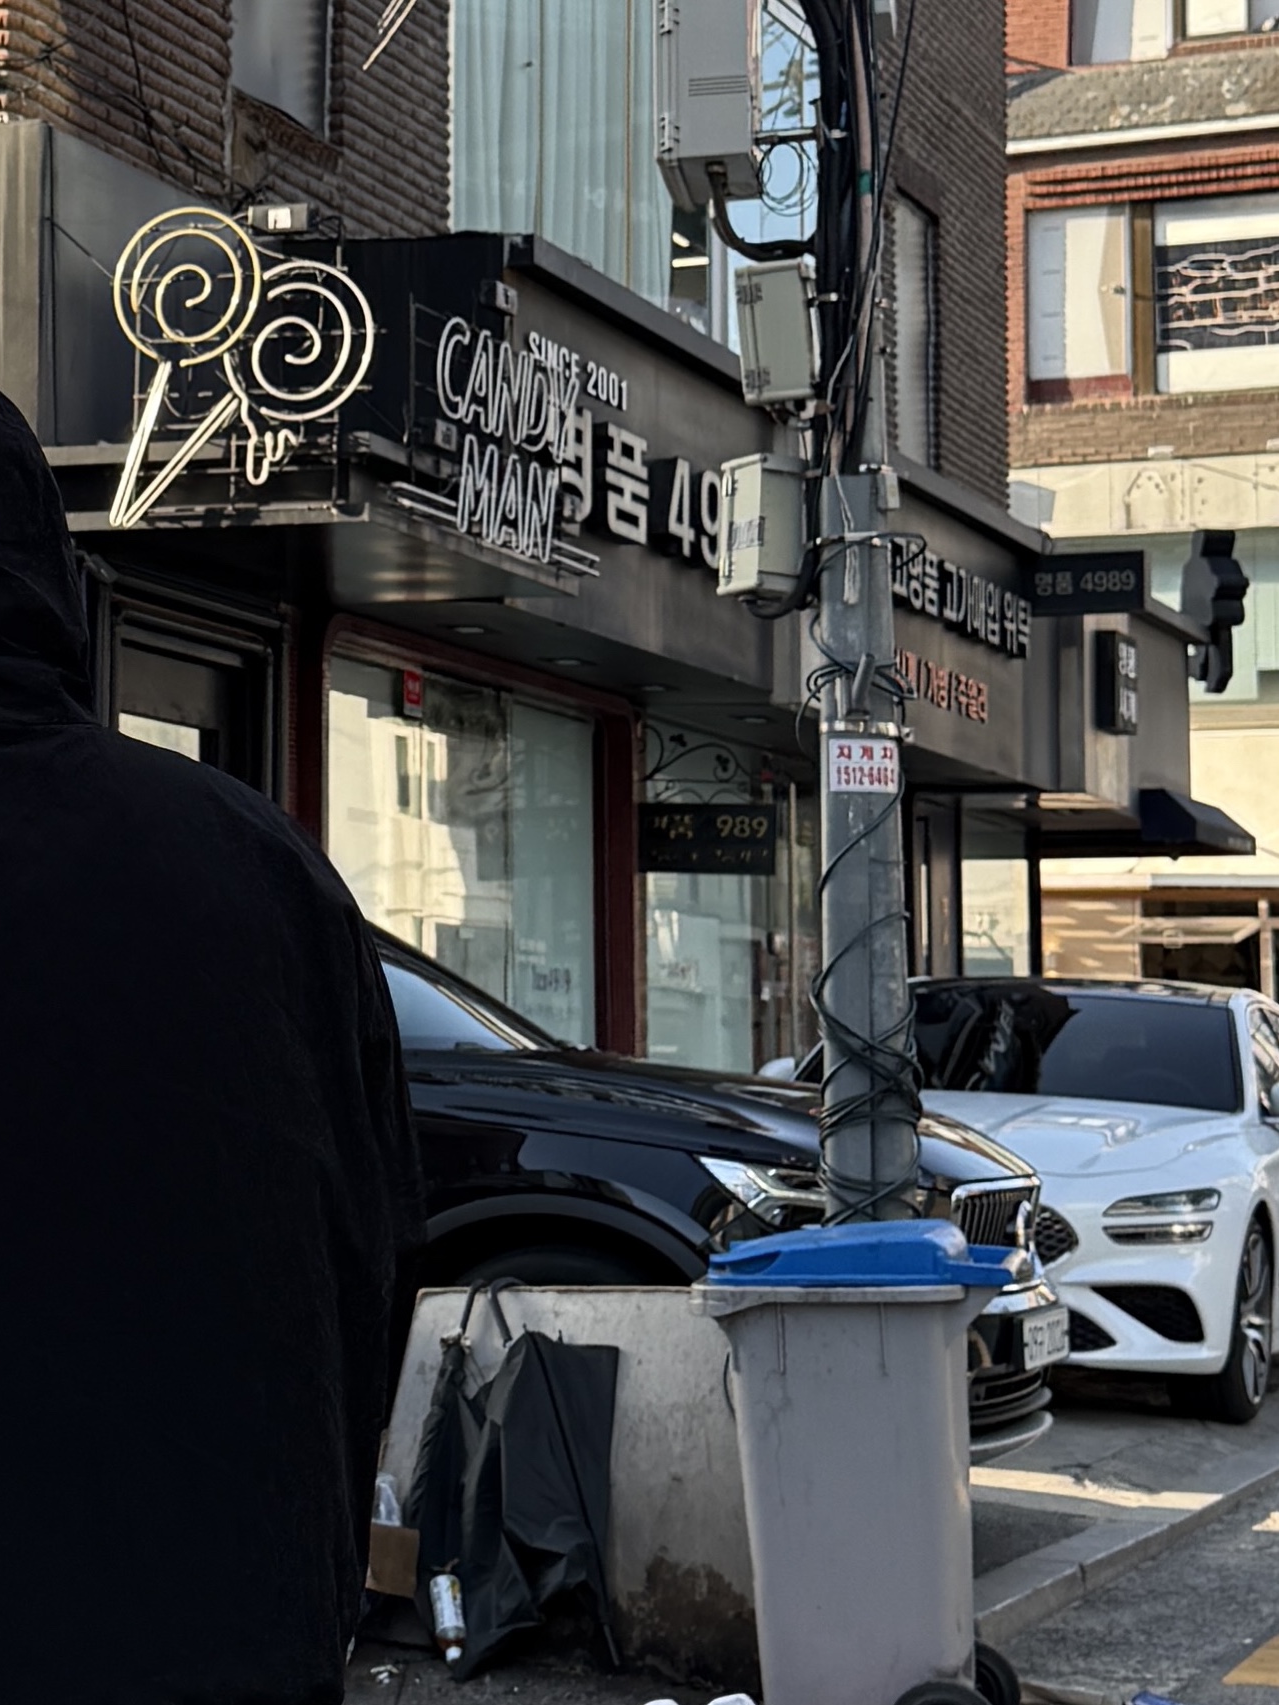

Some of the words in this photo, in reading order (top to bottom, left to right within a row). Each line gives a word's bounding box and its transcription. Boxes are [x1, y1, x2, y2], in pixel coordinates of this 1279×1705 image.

[436, 316, 581, 464] CANDY
[529, 331, 580, 380] SINCE
[586, 361, 628, 411] 2001
[456, 434, 559, 564] MAN
[668, 456, 721, 571] 49
[942, 560, 1001, 646] 고가매입
[1034, 571, 1073, 596] 명품
[1080, 569, 1136, 592] 4989
